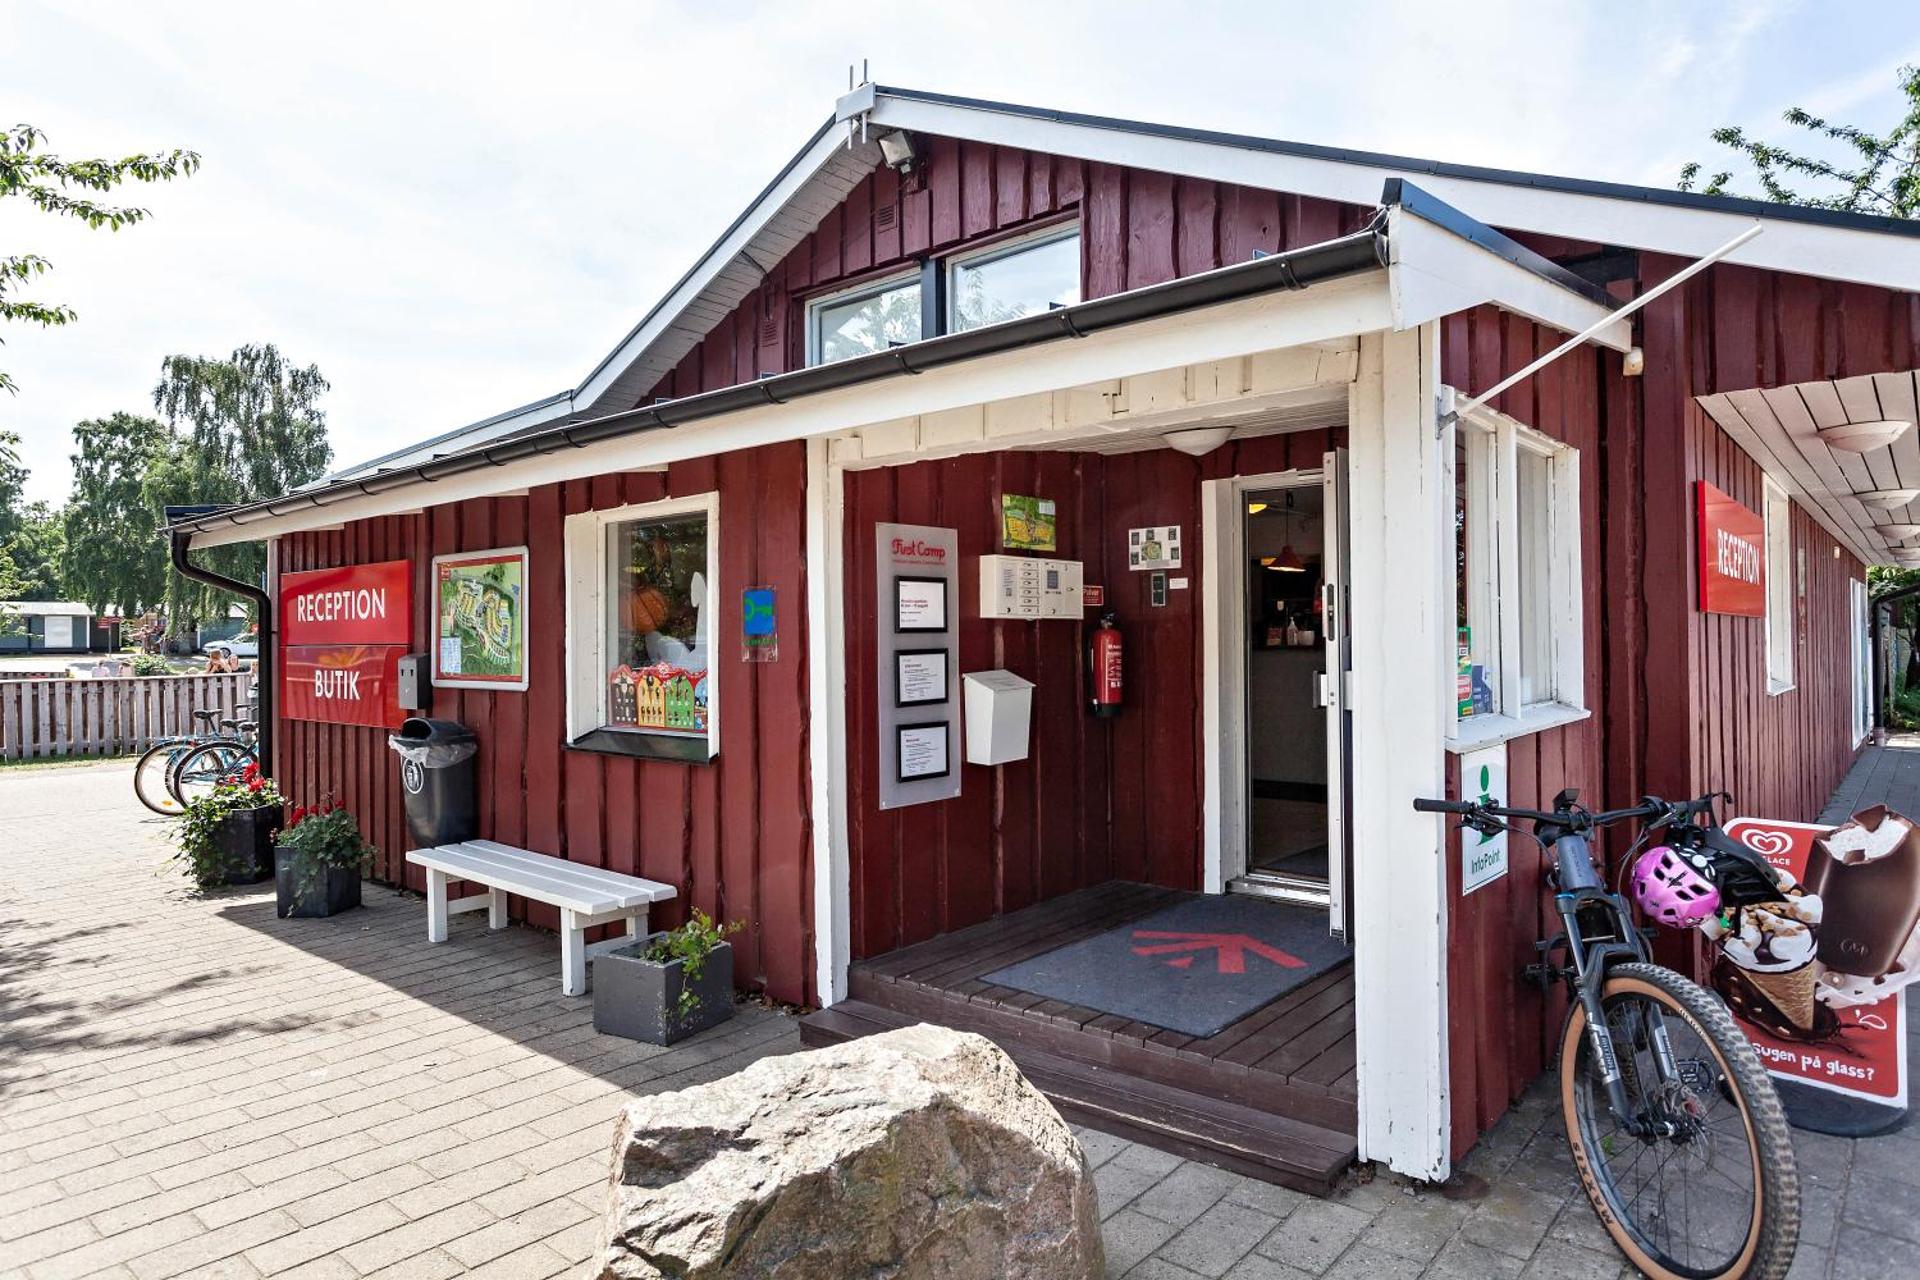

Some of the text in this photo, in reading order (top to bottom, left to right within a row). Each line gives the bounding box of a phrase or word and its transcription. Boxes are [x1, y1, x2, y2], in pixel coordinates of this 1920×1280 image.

[917, 541, 946, 560] Camp
[1717, 527, 1760, 585] RECEPTION
[297, 588, 386, 622] RECEPTION
[315, 669, 360, 700] BUTIK
[1471, 847, 1501, 875] InfoPoint
[1752, 1042, 1875, 1081] Sugen på glass?
[1572, 1141, 1615, 1226] MAXXIS
